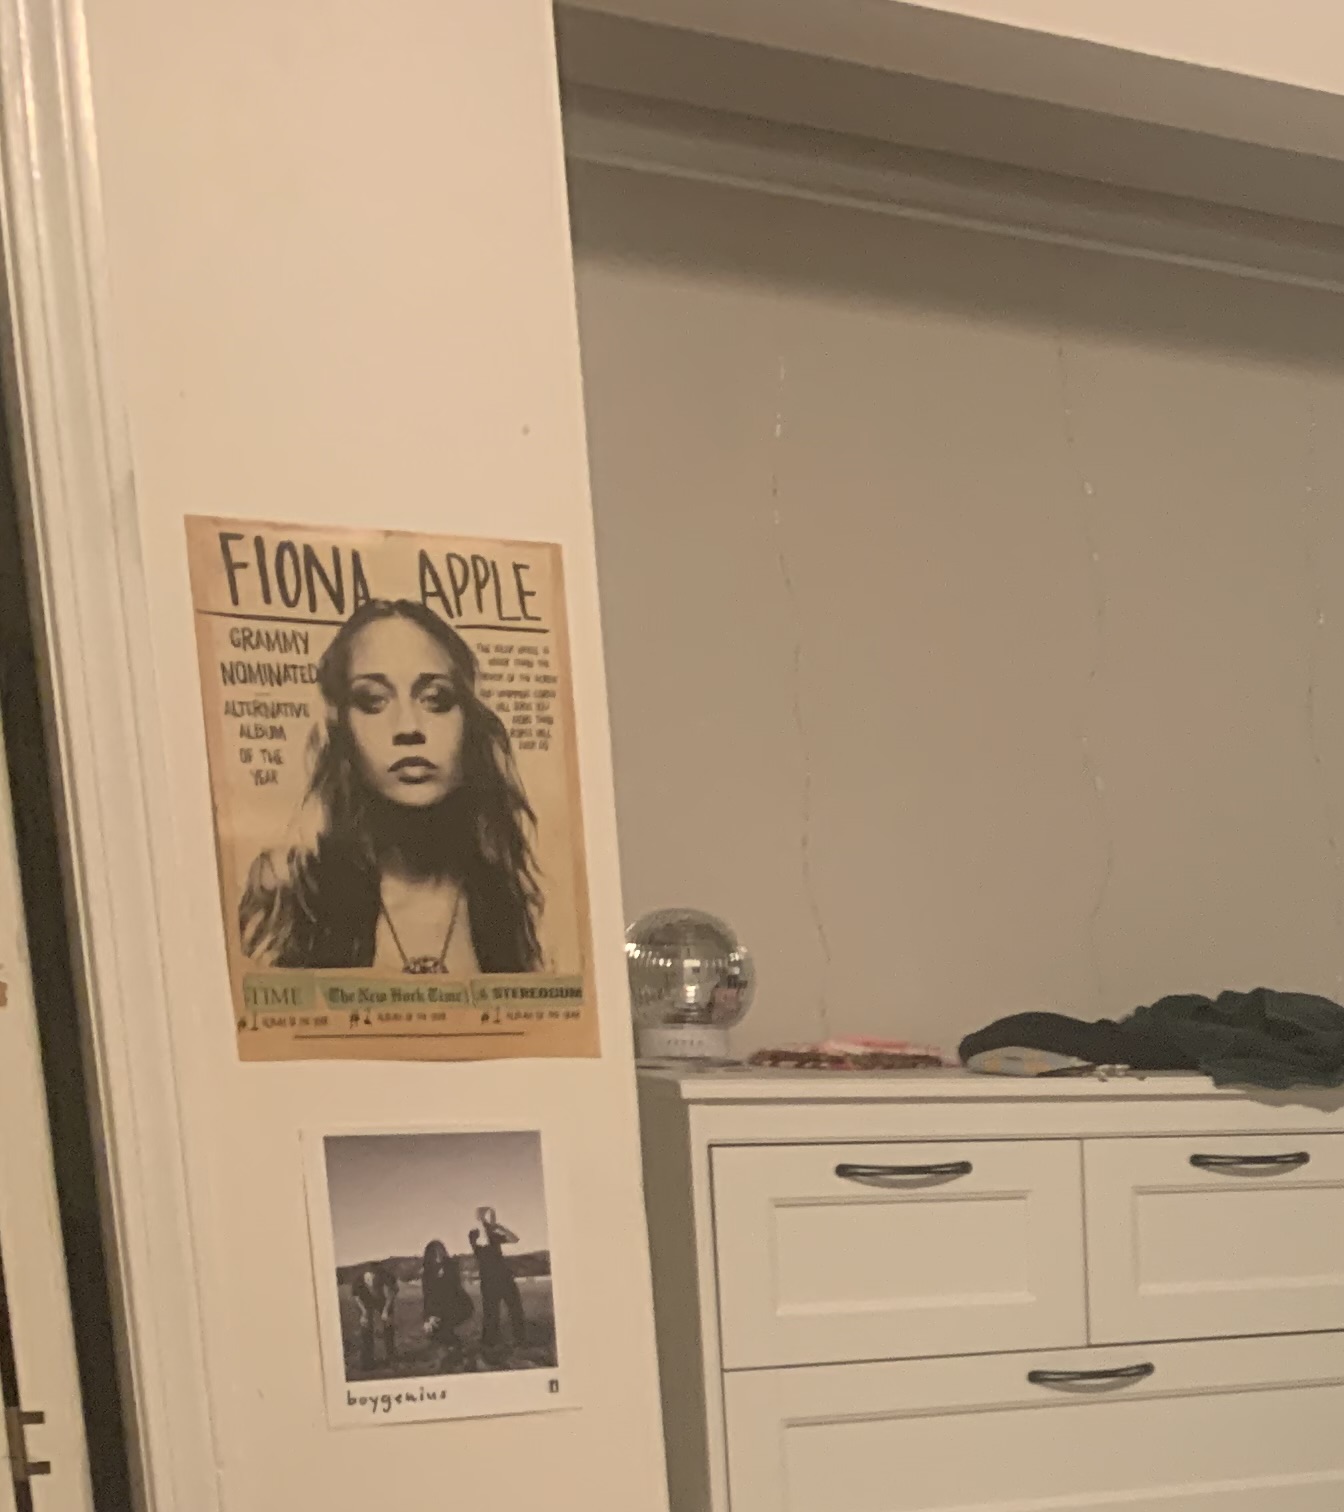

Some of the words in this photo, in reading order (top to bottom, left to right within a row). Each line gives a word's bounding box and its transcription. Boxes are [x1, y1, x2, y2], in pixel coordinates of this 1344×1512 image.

[219, 531, 371, 615] FIONA
[418, 548, 542, 622] APPLE
[229, 626, 310, 656] GRAMMY
[220, 660, 319, 688] NOMINATED
[224, 699, 311, 720] ALTERNATIVE
[239, 722, 287, 742] ALBUM
[346, 1385, 448, 1414] boygenius
